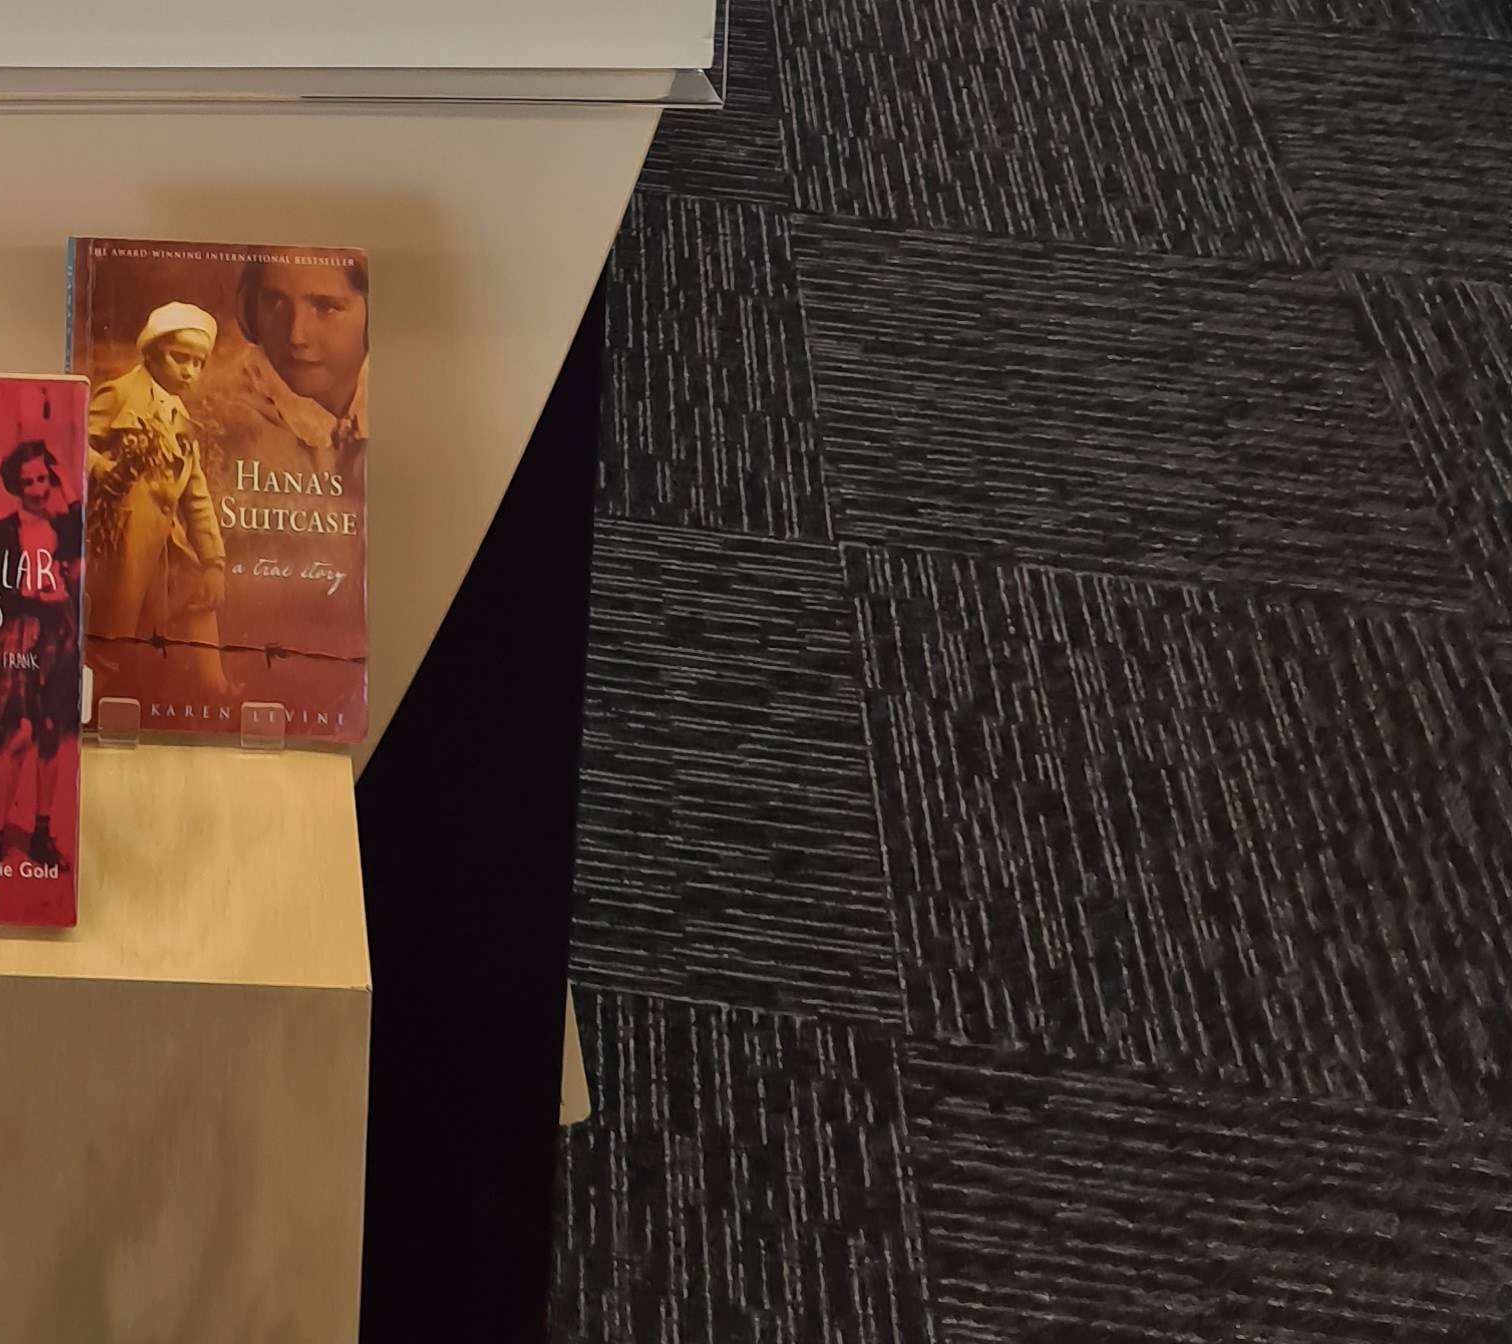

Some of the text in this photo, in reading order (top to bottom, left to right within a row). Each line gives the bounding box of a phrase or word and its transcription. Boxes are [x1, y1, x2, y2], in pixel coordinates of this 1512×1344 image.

[205, 251, 291, 265] INTERNATIONAL
[294, 256, 356, 267] BESTSELLER
[236, 459, 343, 497] HANA'S
[220, 495, 358, 536] SUITCASE
[231, 562, 244, 575] a
[2, 650, 40, 671] FRANK
[150, 703, 232, 721] KAREN
[19, 861, 59, 880] Gold
